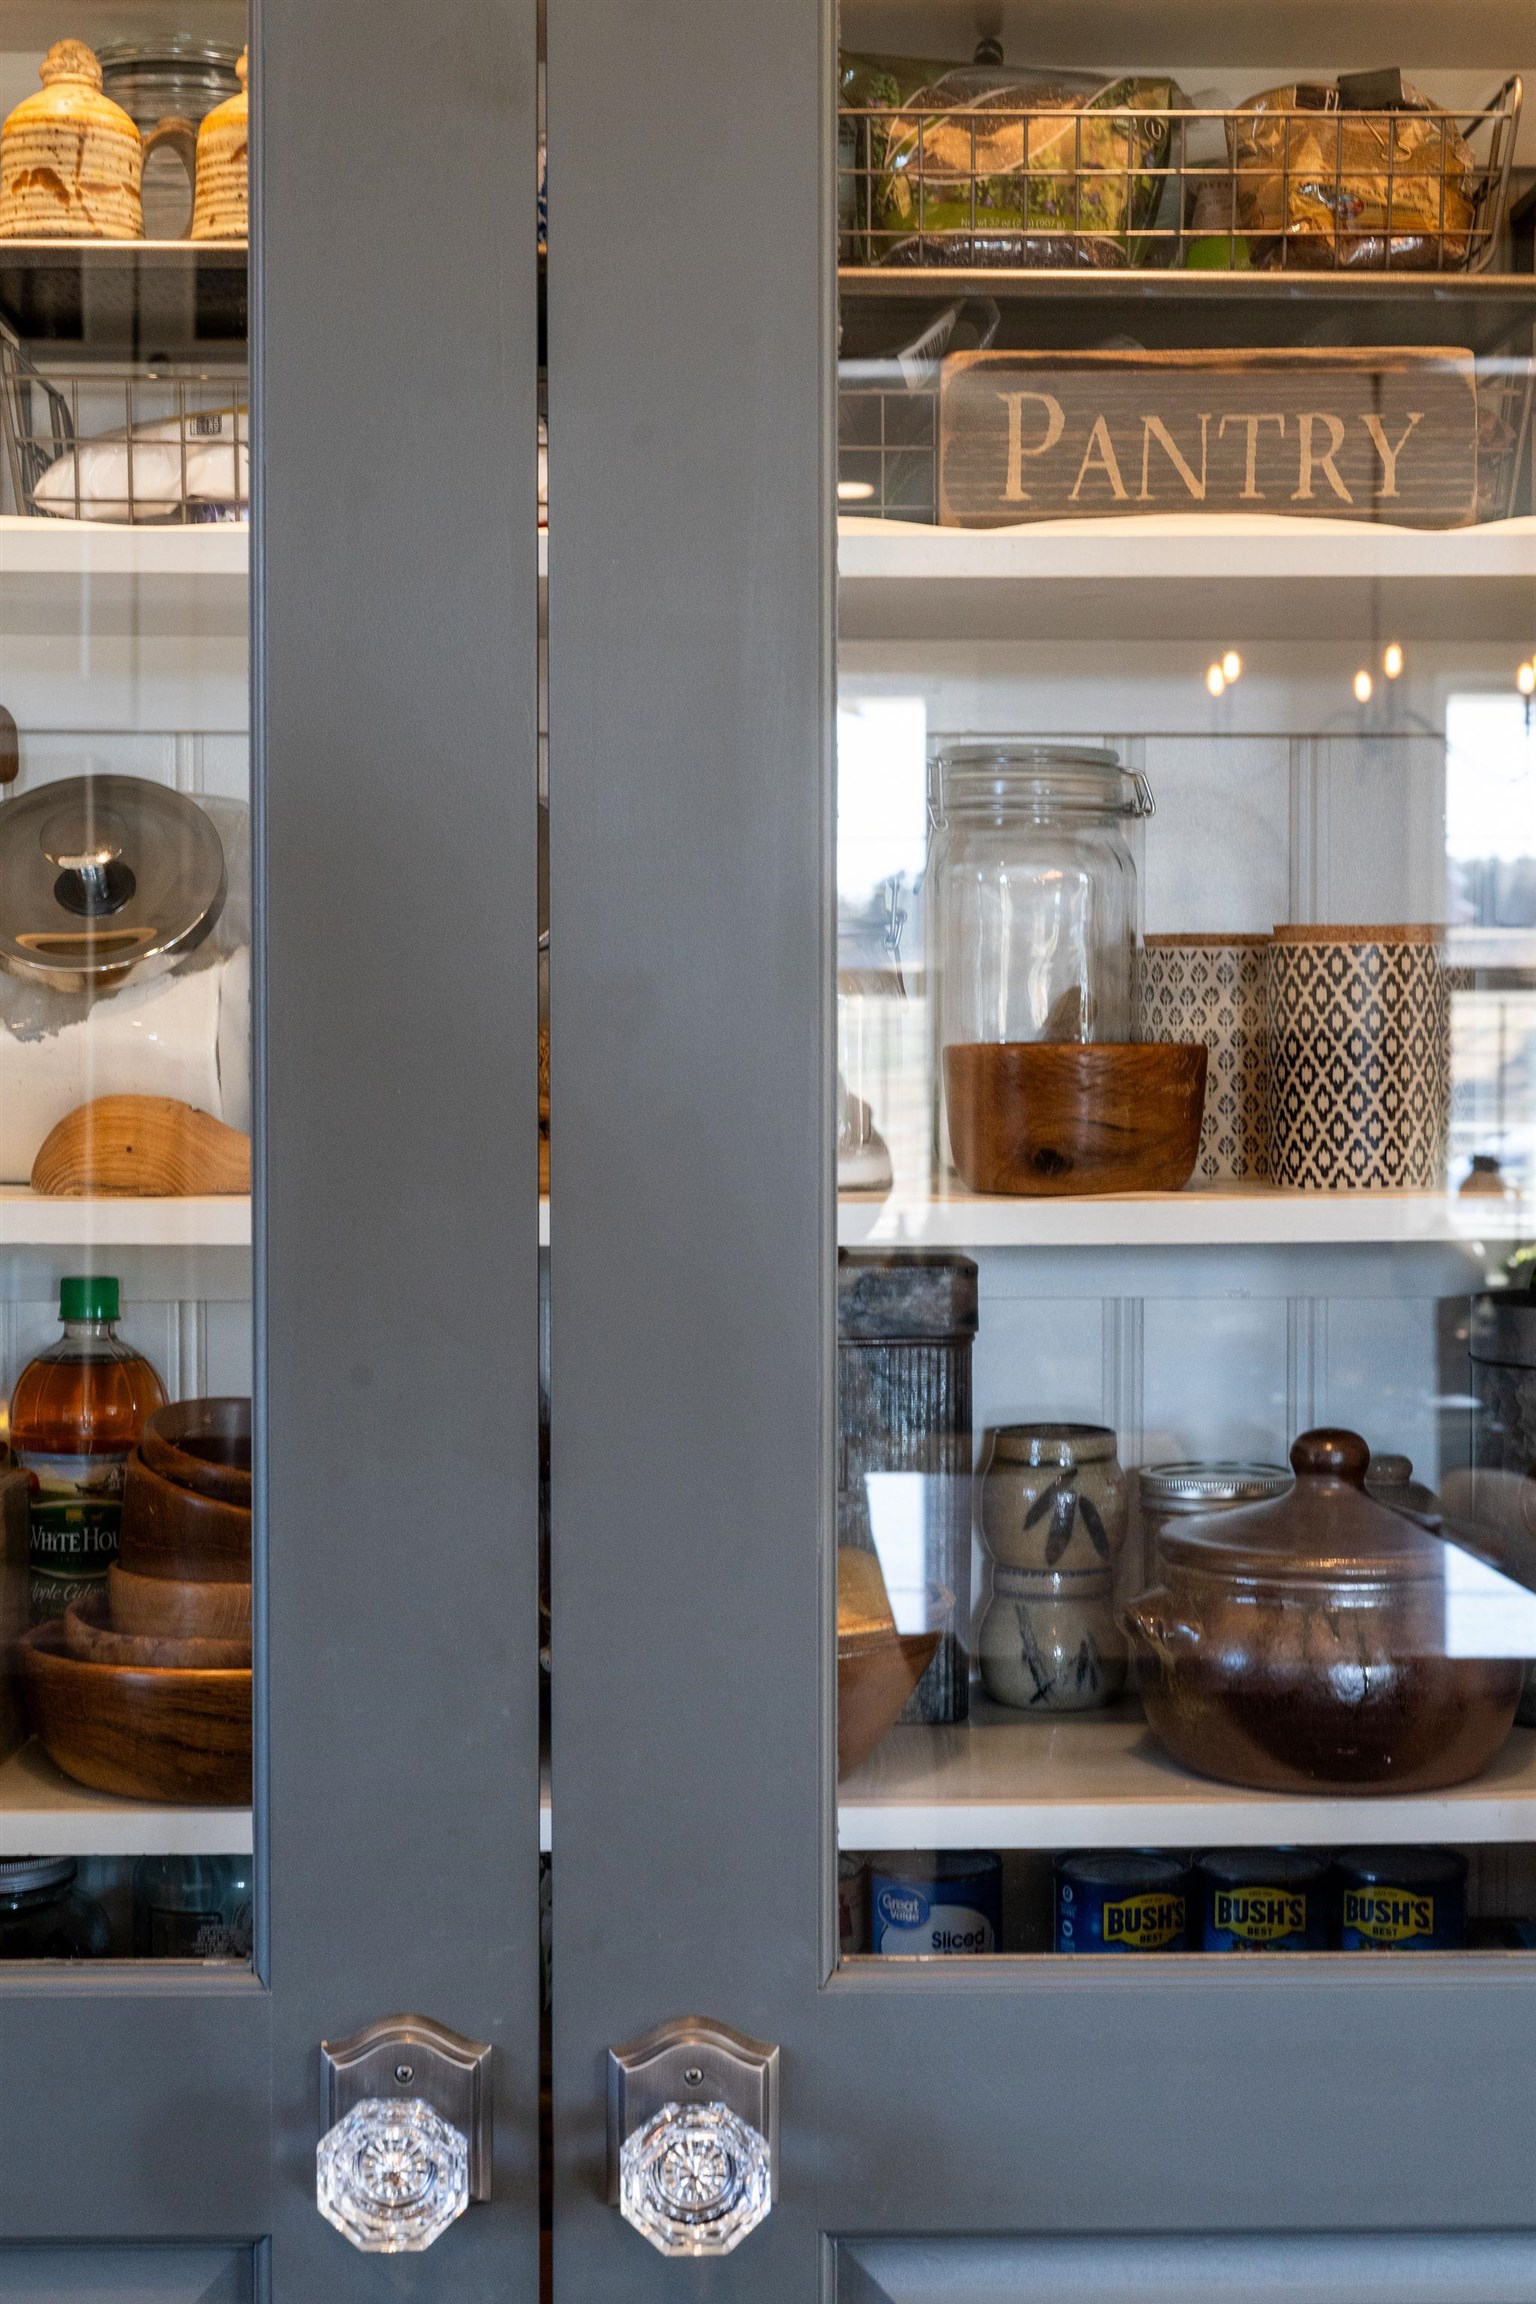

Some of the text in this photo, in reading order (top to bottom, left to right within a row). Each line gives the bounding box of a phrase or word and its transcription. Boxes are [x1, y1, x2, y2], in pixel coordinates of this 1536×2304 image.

[30, 1524, 121, 1553] WHITE HOU
[883, 1893, 919, 1912] Great
[890, 1909, 920, 1923] Value
[1218, 1896, 1302, 1927] BUSH'S
[1346, 1895, 1431, 1930] BUSH'S
[1108, 1901, 1184, 1935] BUSH'S
[932, 1927, 985, 1949] Sliced
